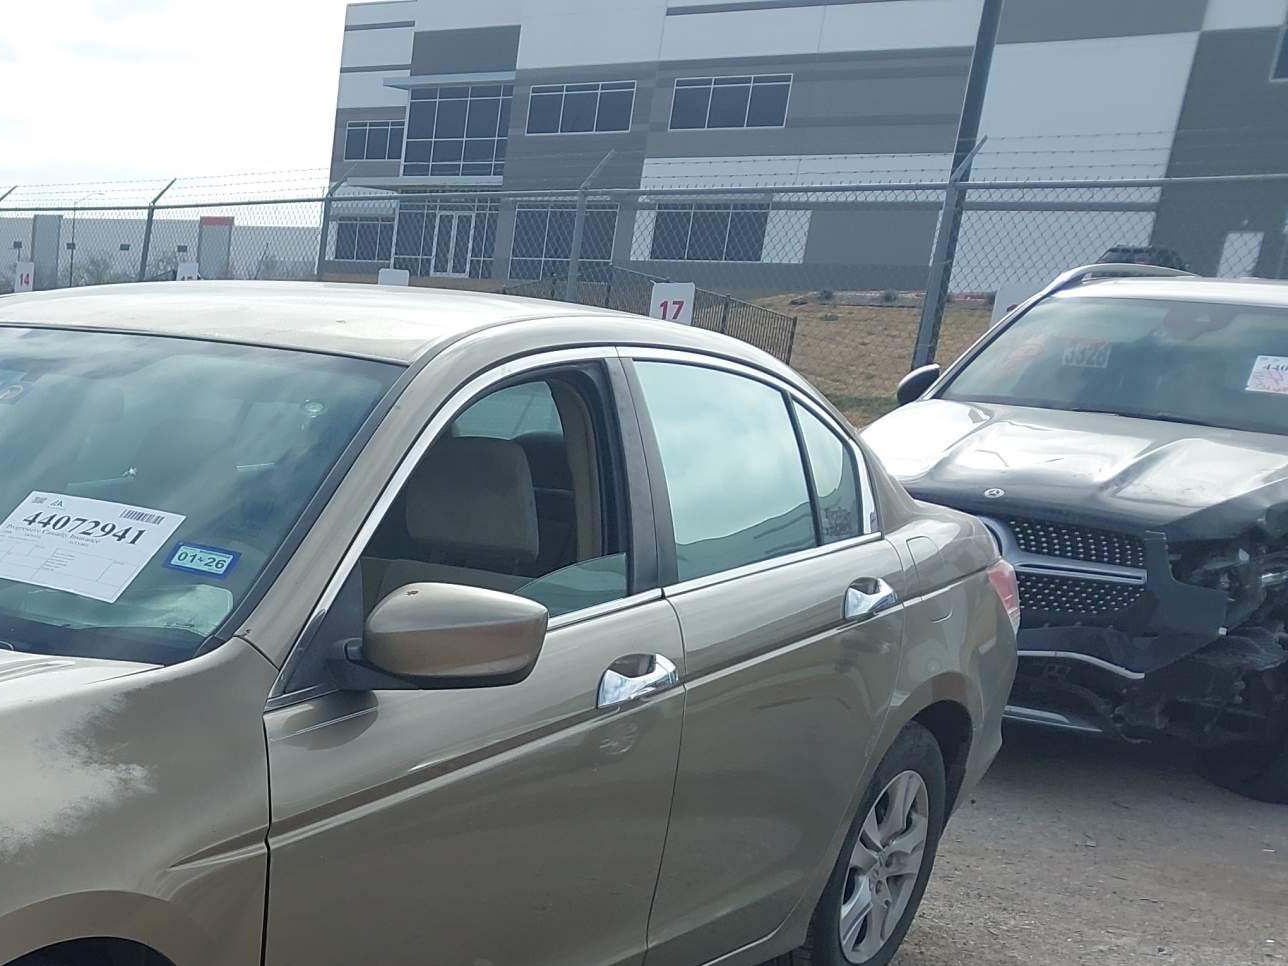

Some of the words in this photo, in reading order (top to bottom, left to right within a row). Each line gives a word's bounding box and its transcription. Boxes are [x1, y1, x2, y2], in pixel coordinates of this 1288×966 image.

[20, 273, 30, 286] 14
[660, 300, 685, 321] 17
[23, 511, 146, 544] 44072941
